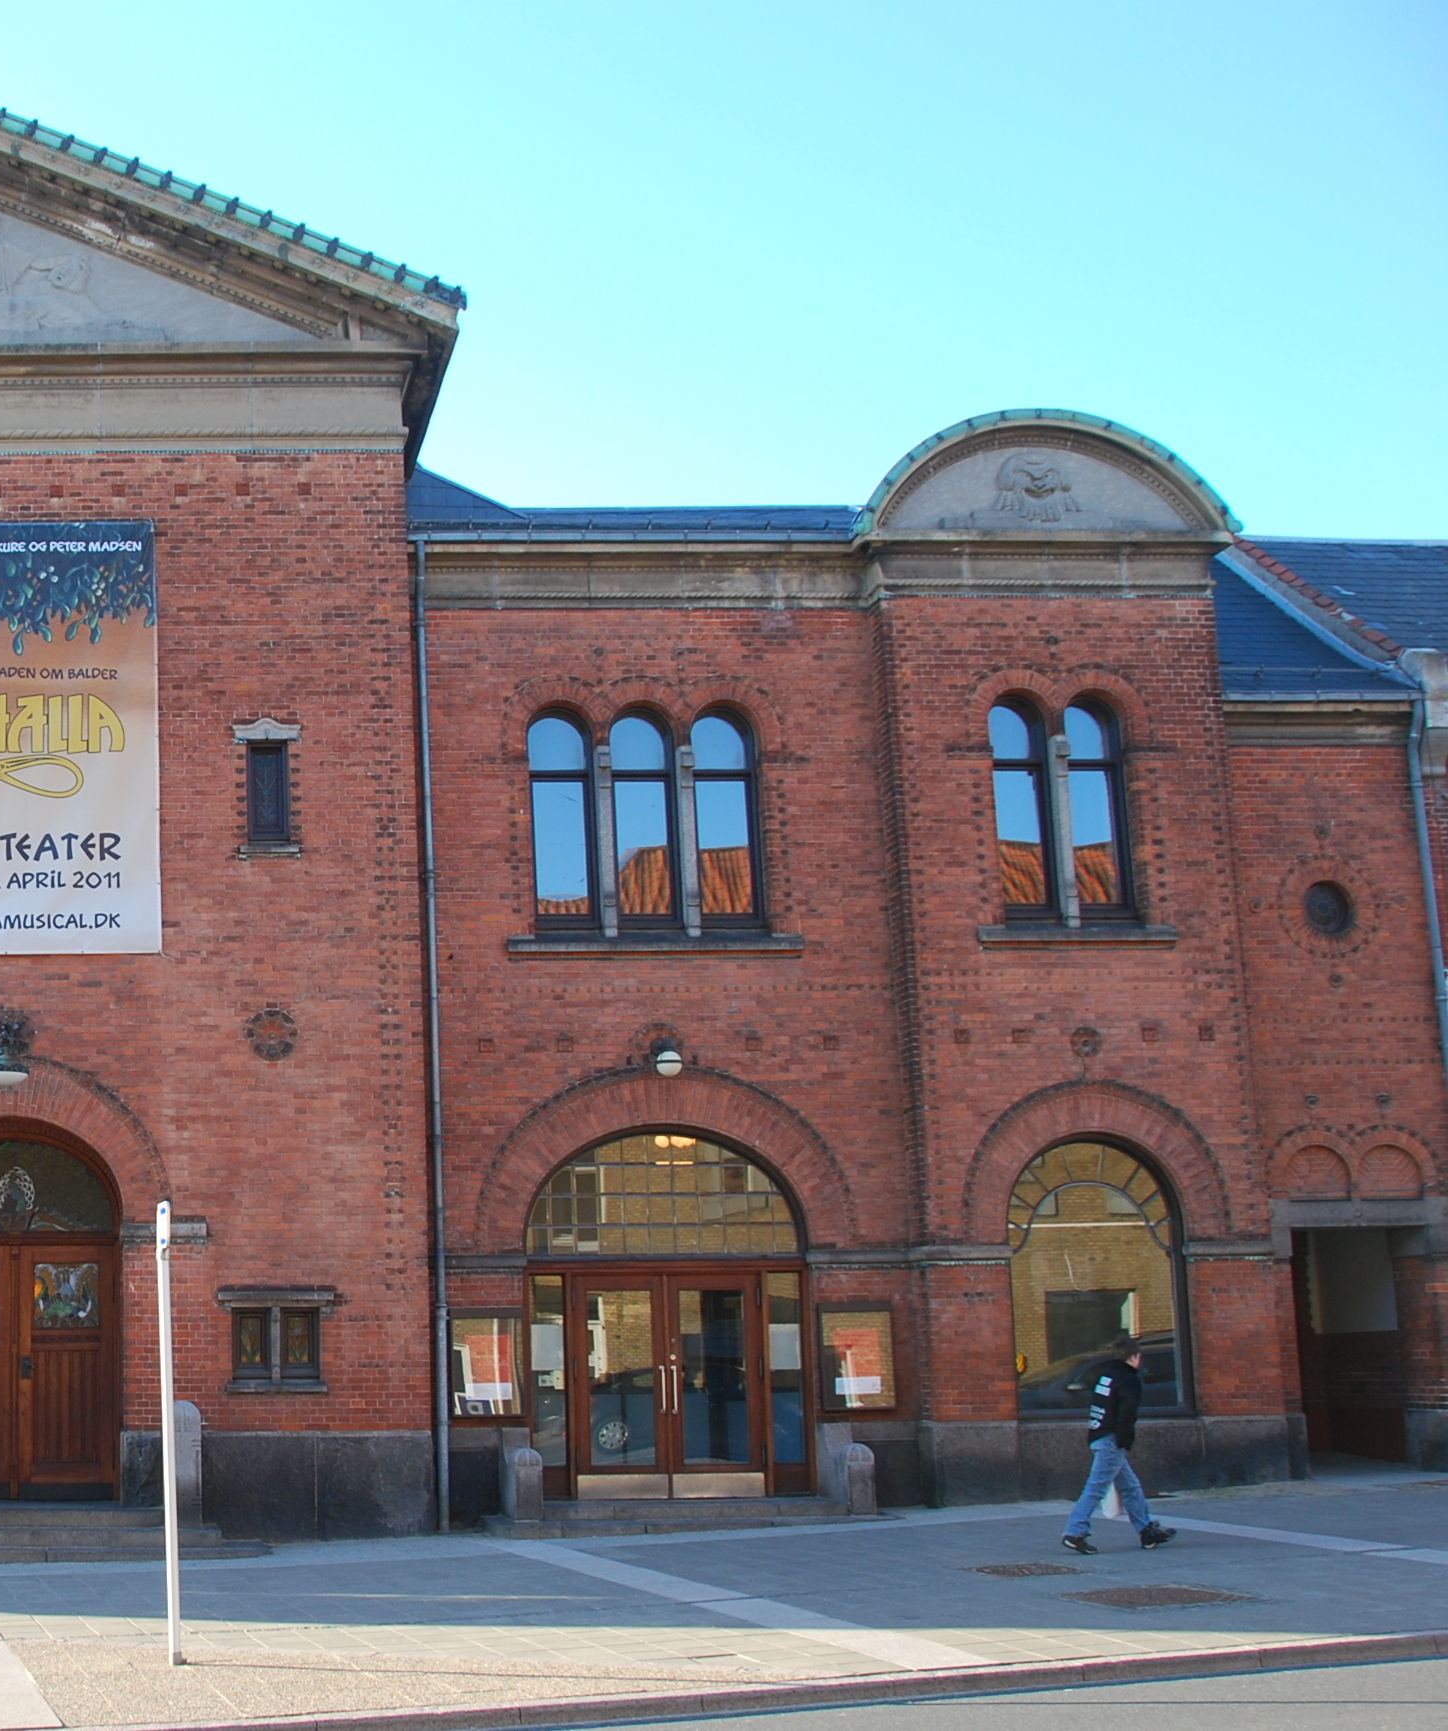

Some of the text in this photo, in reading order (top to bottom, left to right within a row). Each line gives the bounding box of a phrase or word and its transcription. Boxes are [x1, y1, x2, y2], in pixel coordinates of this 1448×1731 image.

[28, 541, 47, 551] OG
[50, 541, 85, 552] PETER
[88, 540, 142, 552] MADSEN
[39, 667, 64, 679] OM
[68, 668, 118, 680] BALDER
[0, 832, 122, 862] TEATER
[72, 871, 121, 889] 2011
